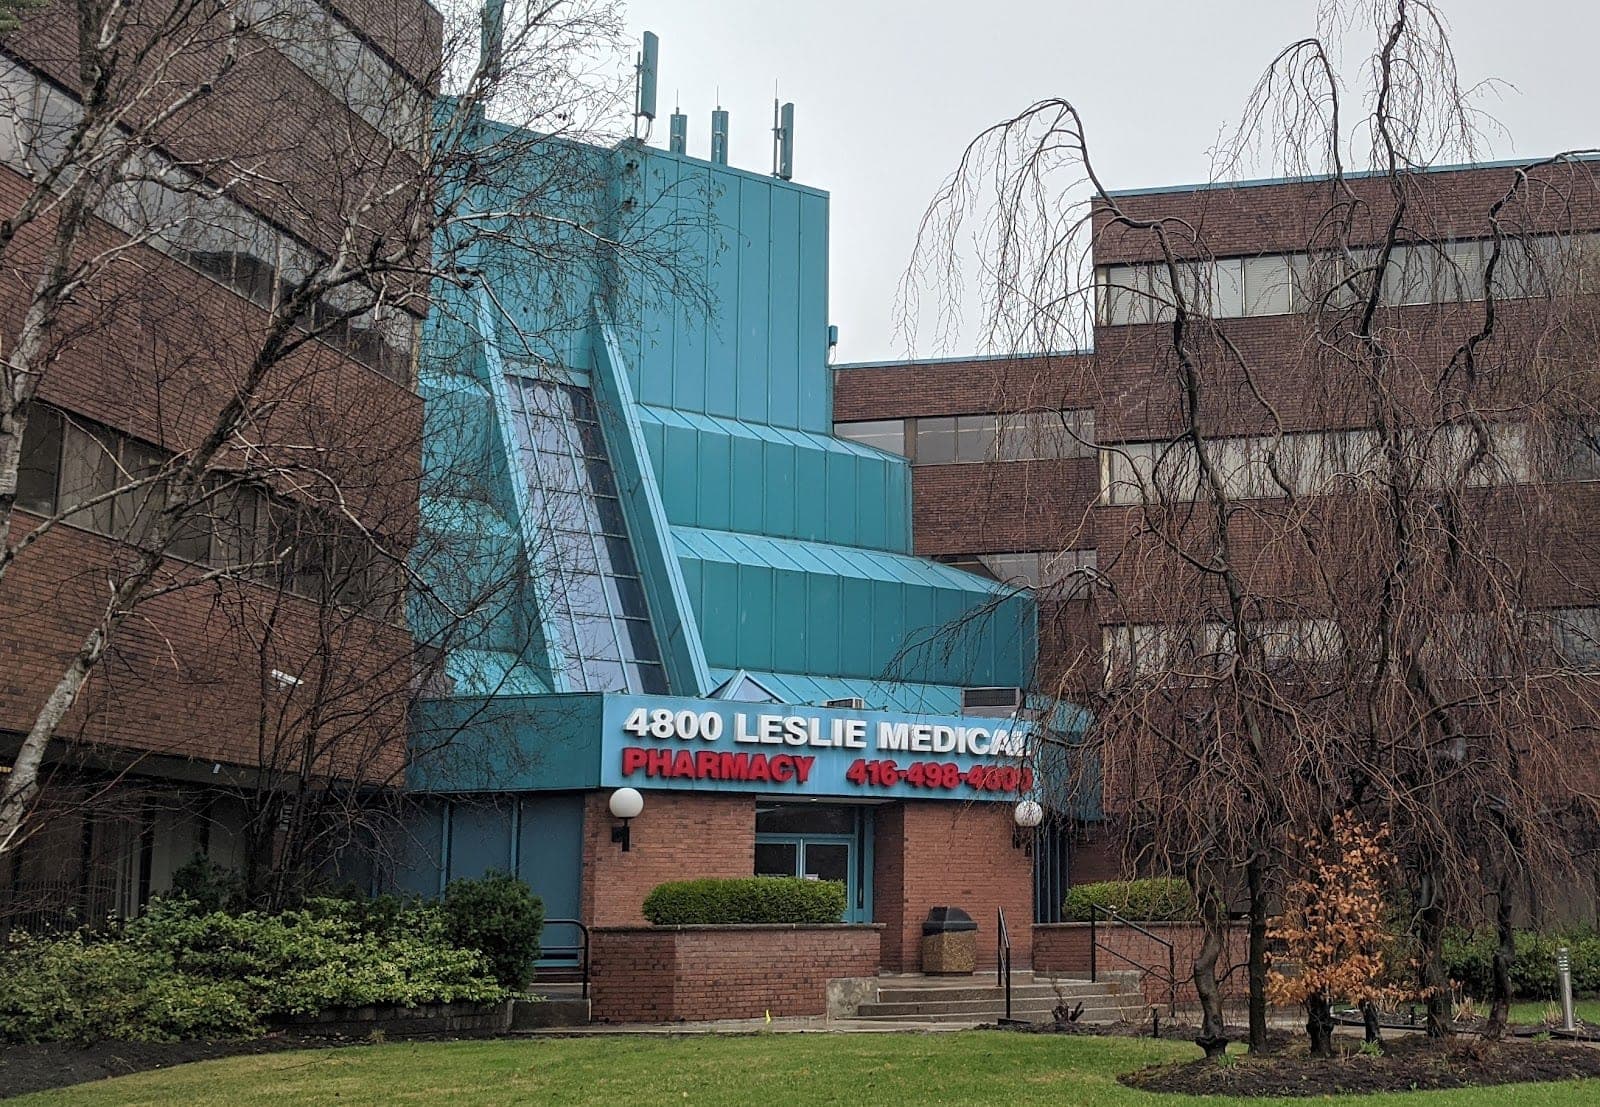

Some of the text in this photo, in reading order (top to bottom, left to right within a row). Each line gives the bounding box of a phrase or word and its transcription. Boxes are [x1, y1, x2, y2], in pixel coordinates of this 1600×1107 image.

[623, 707, 1032, 757] 4800 LESLIE MEDICAL
[622, 746, 815, 784] PHARMACY
